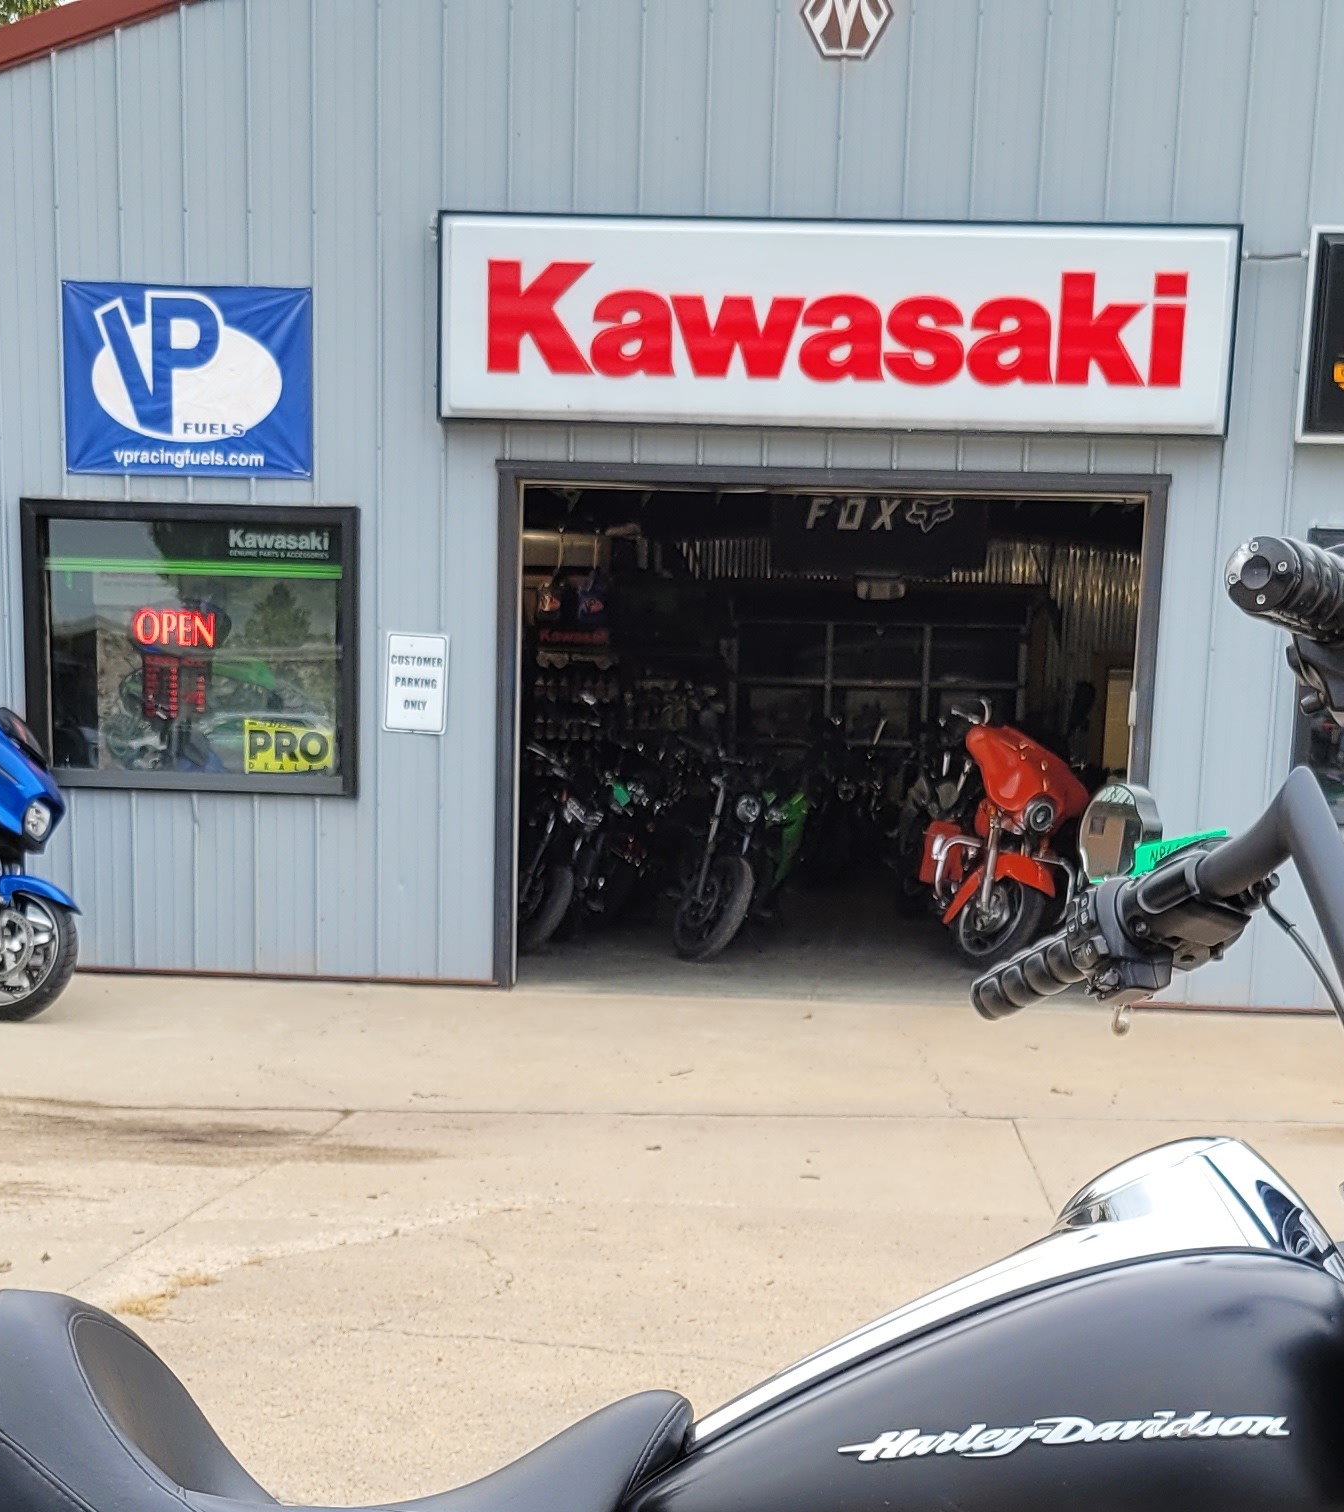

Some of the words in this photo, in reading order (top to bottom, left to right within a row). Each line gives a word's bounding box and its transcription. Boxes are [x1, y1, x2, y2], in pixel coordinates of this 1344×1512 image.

[486, 258, 1190, 388] Kawasaki
[95, 291, 223, 437] VP
[183, 423, 244, 436] FUELS
[113, 447, 264, 468] vpracingfuels.com
[806, 497, 903, 531] FOX
[230, 528, 330, 551] Kawasaki
[259, 550, 280, 558] PARTS
[133, 607, 217, 648] OPEN
[391, 654, 443, 669] CUSTOMER
[394, 676, 438, 690] PARKING
[403, 698, 428, 711] ONLY
[248, 729, 329, 763] PRO
[837, 1410, 1291, 1462] Harley-Davidson
